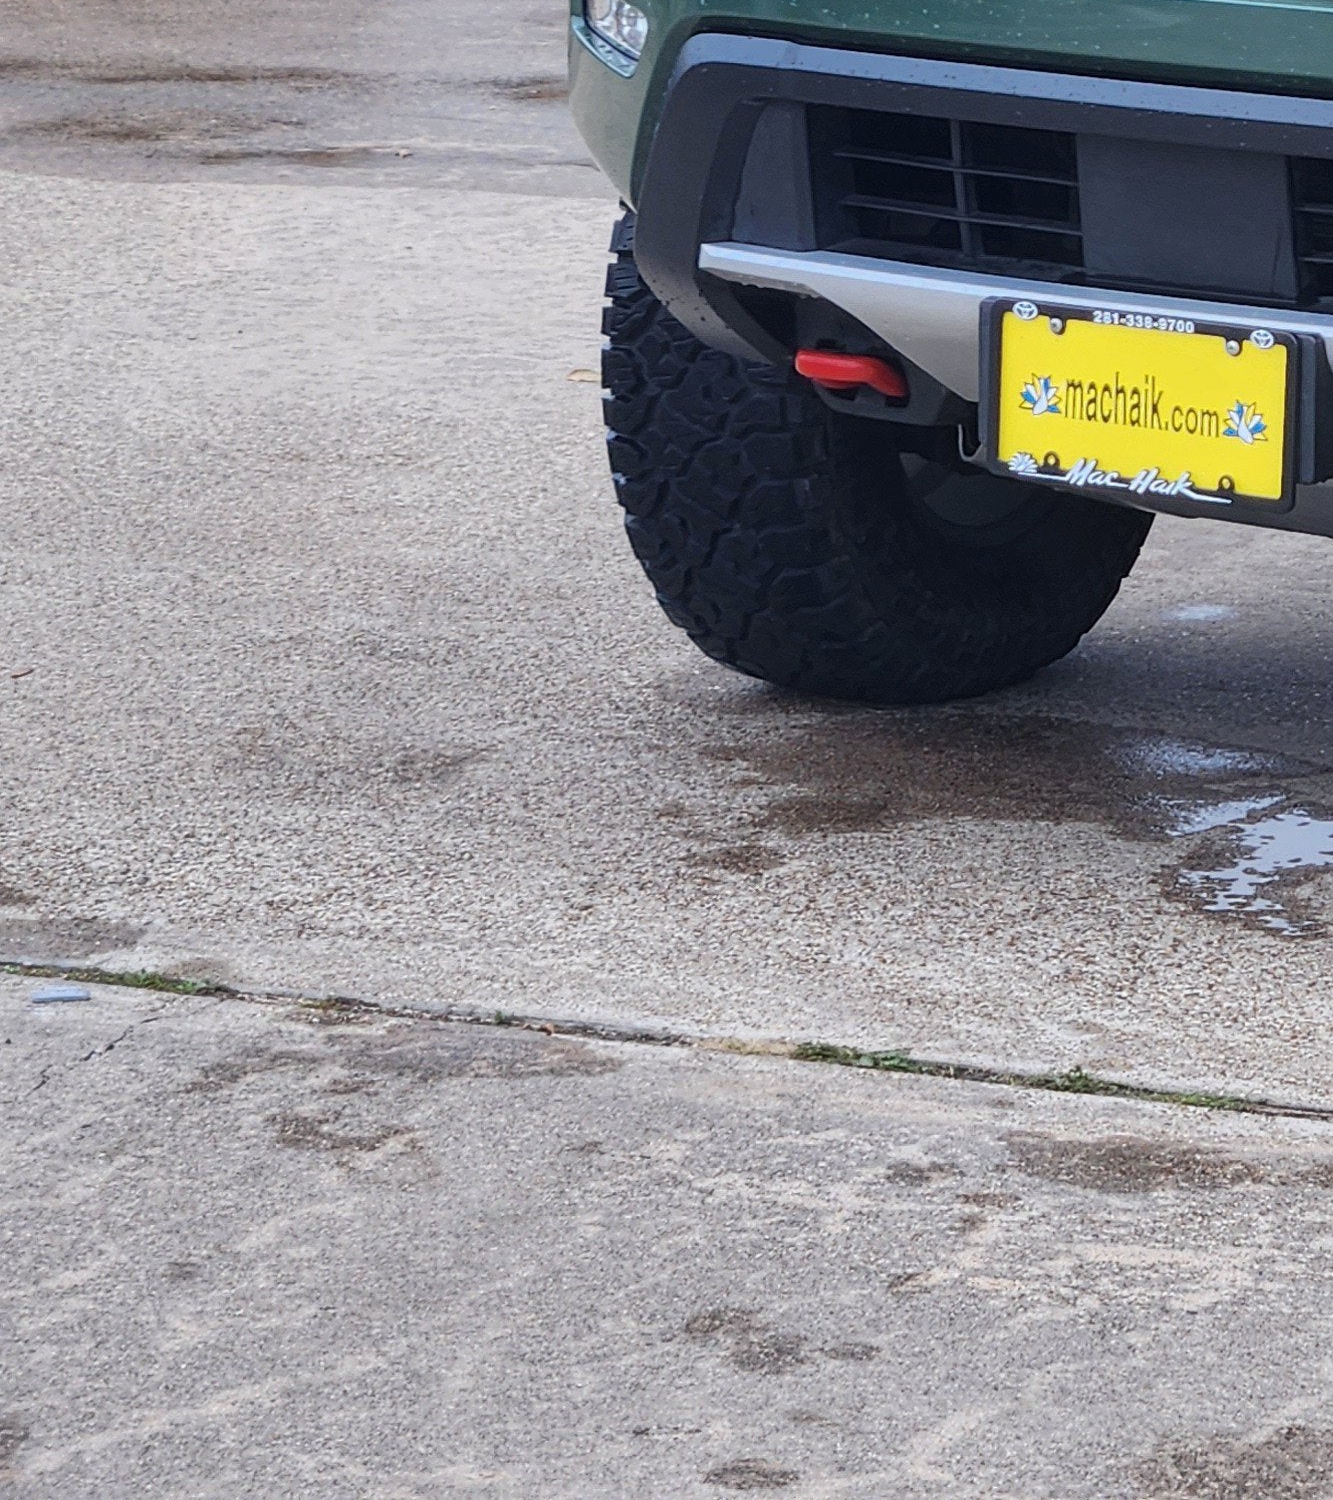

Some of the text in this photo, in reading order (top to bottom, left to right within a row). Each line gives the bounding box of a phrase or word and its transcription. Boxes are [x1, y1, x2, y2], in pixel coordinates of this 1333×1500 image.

[1093, 310, 1195, 334] 281-338-9700
[1063, 372, 1221, 438] machaik.com
[1064, 457, 1196, 496] Mac Haik
